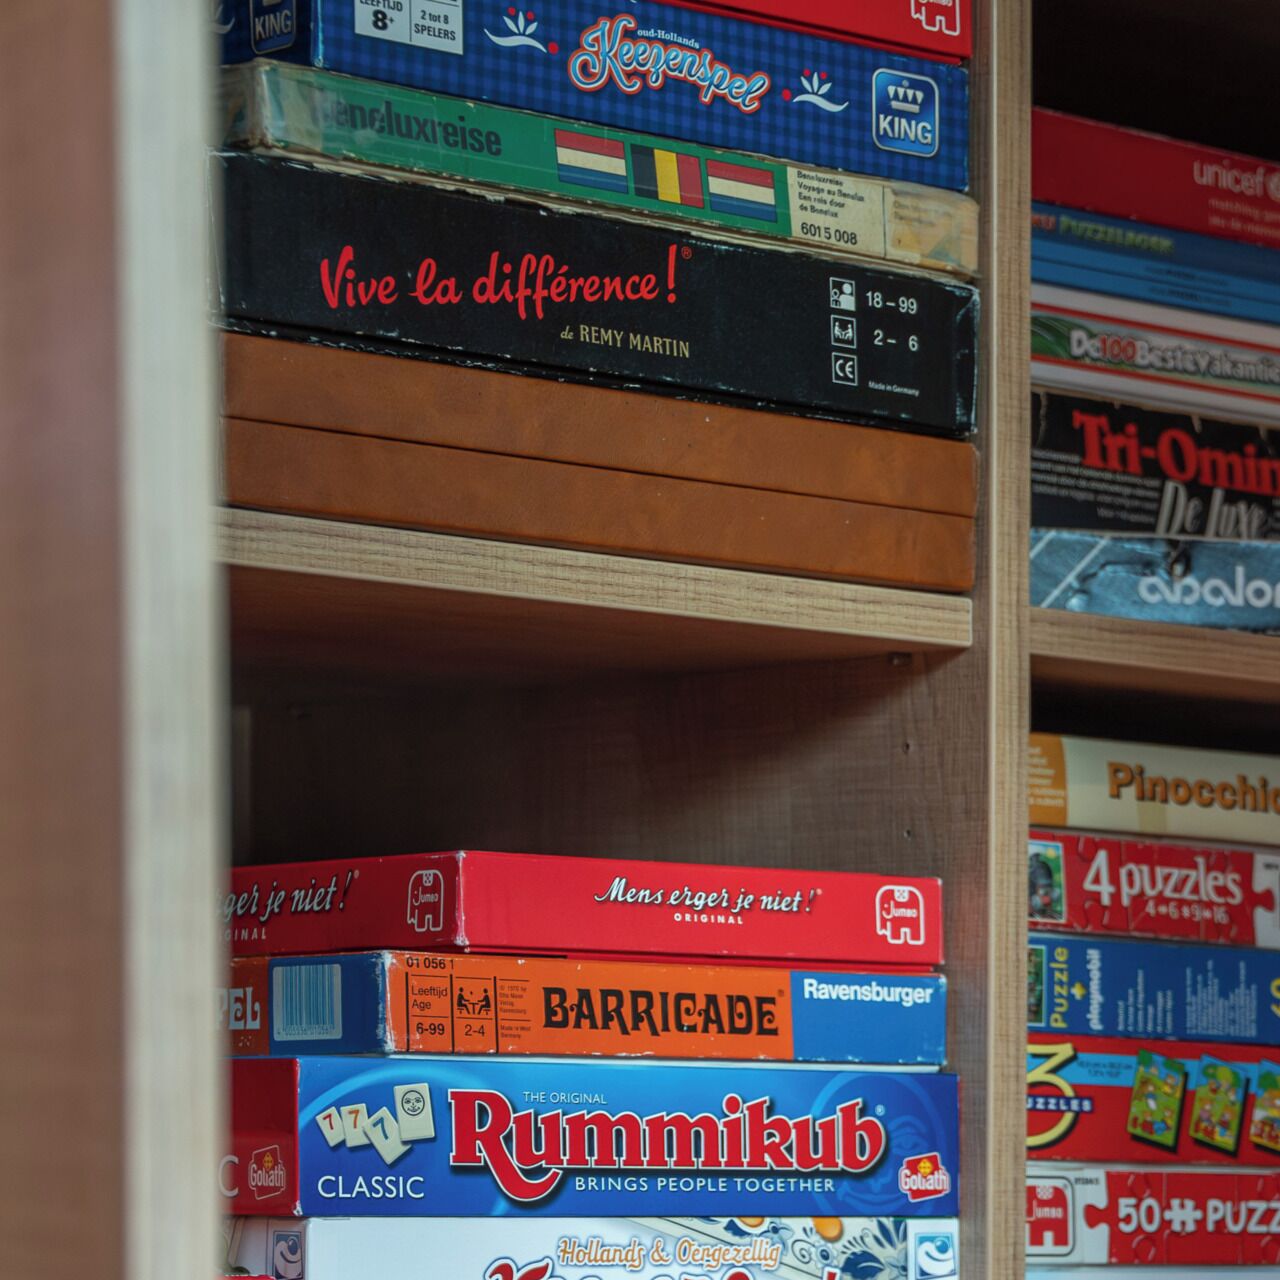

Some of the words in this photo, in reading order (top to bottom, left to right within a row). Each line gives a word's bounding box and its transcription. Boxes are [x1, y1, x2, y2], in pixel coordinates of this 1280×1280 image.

[254, 10, 293, 39] KING
[420, 10, 426, 20] 2
[429, 12, 440, 23] tot
[443, 15, 449, 24] 8
[414, 23, 456, 41] SPELERS
[637, 28, 700, 49] oud-Hollands
[569, 14, 770, 113] Keezenspel
[878, 113, 933, 145] KING
[1192, 158, 1266, 198] unicef
[800, 222, 821, 237] 601
[834, 229, 858, 245] 008
[320, 245, 398, 309] Vive
[408, 257, 462, 305] la
[560, 325, 575, 341] de
[579, 324, 624, 348] REMY
[629, 333, 691, 359] MARTIN
[873, 330, 883, 346] 2
[908, 335, 918, 352] 6
[868, 380, 885, 391] Made
[892, 384, 920, 398] Germany
[1082, 849, 1116, 906] 4
[1118, 857, 1243, 908] puzzles
[260, 881, 286, 923] je
[413, 886, 439, 906] Jumbo
[594, 876, 664, 905] Mens
[666, 886, 729, 910] erger
[730, 890, 752, 912] je
[673, 912, 745, 925] ORIGINAL
[882, 899, 918, 919] Jumbo
[406, 957, 420, 969] 01
[423, 957, 447, 970] 056
[449, 958, 455, 970] 1
[411, 984, 448, 1000] Leeftijd
[803, 977, 934, 1007] Ravensburger
[1050, 946, 1069, 1030] Puzzle
[1086, 948, 1104, 1032] playmobil
[411, 999, 432, 1011] Age
[542, 985, 779, 1037] BARRICADE
[416, 1021, 446, 1036] 6-99
[464, 1023, 486, 1038] 2-4
[522, 1091, 548, 1103] THE
[549, 1091, 607, 1105] ORIGINAL
[322, 1113, 336, 1131] 7
[347, 1109, 361, 1130] 7
[372, 1117, 389, 1142] 7
[448, 1090, 887, 1203] Rummikub
[251, 1162, 284, 1189] Goliath
[317, 1175, 425, 1199] CLASSIC
[575, 1177, 649, 1192] BRINGS
[656, 1177, 728, 1192] PEOPLE
[732, 1177, 836, 1193] TOGETHER
[899, 1165, 950, 1193] Goliath
[1117, 1197, 1162, 1234] 50
[559, 1237, 646, 1270] Hollands
[650, 1239, 671, 1265] &
[677, 1237, 783, 1270] Oergezellig
